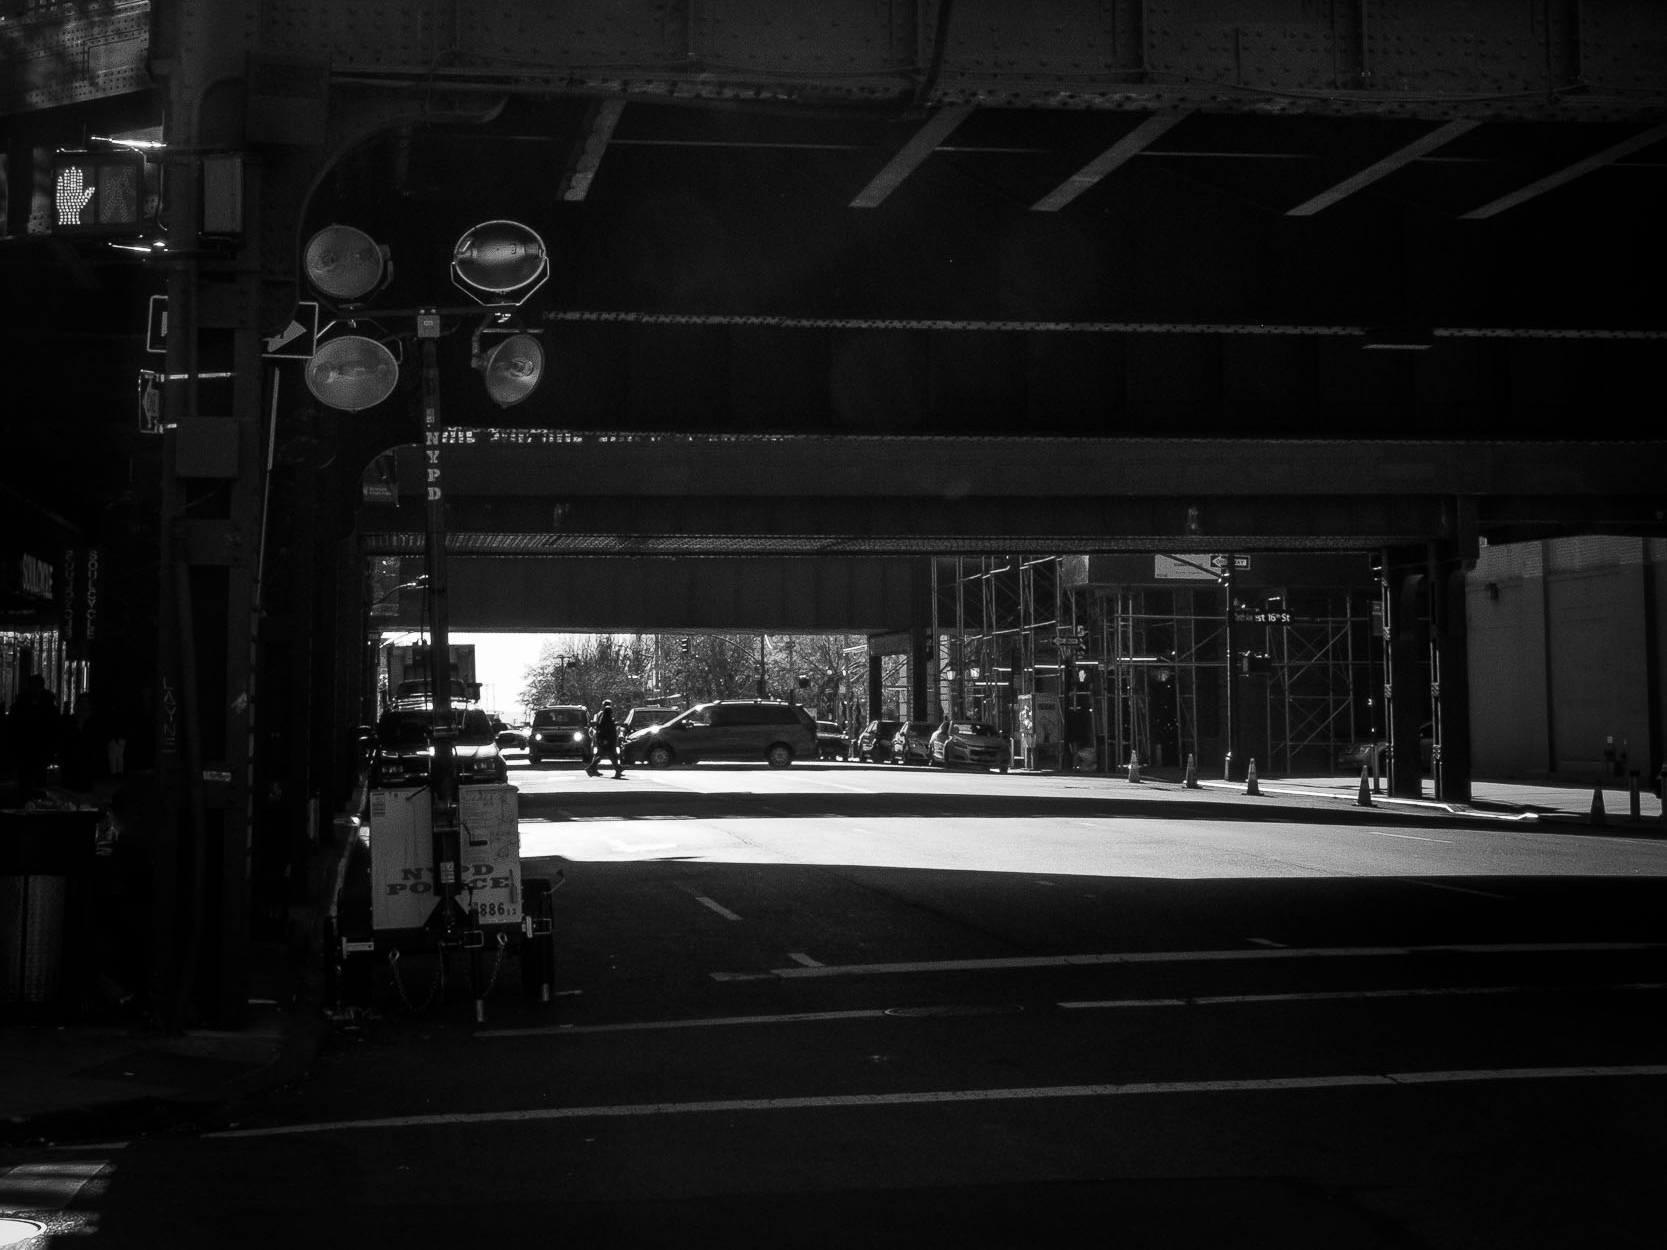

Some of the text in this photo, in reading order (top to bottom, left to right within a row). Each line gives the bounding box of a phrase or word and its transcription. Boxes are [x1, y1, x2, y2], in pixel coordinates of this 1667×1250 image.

[425, 431, 441, 501] NYPD
[1281, 612, 1291, 623] St
[386, 876, 510, 896] POCE
